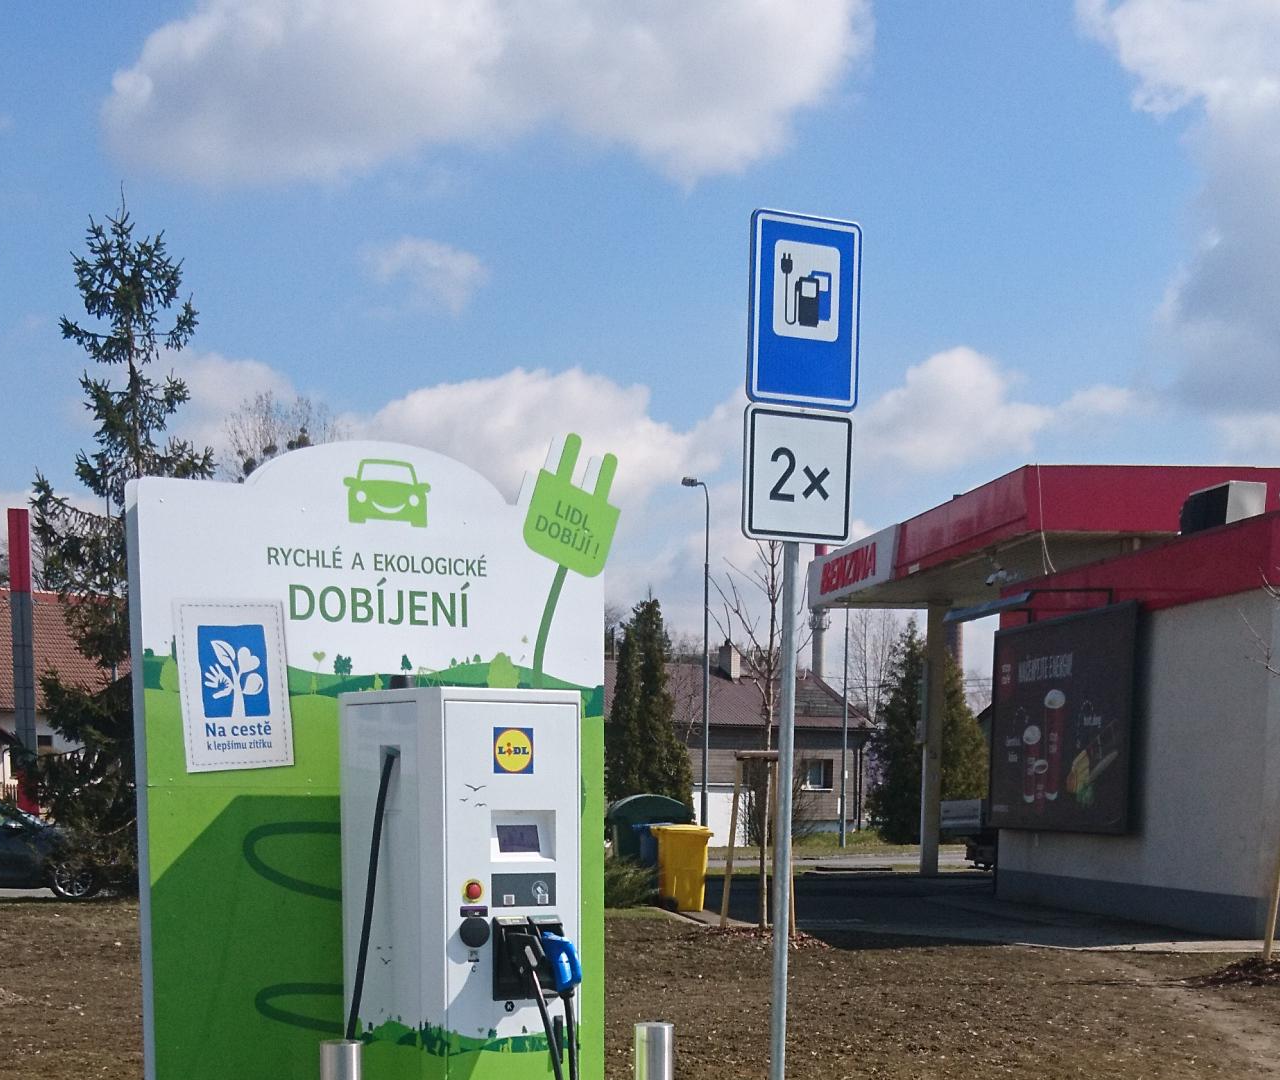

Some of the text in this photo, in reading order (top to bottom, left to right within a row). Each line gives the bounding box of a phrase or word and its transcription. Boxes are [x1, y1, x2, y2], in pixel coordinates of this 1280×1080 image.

[555, 500, 590, 532] LIDL
[267, 546, 487, 577] RYCHLÉ A EKOLOGICKÉ
[820, 542, 877, 595] BENZINA
[289, 577, 470, 628] DOBÍJENÍ
[205, 721, 272, 737] Na cestě
[207, 739, 273, 752] k lepšímu zítřku
